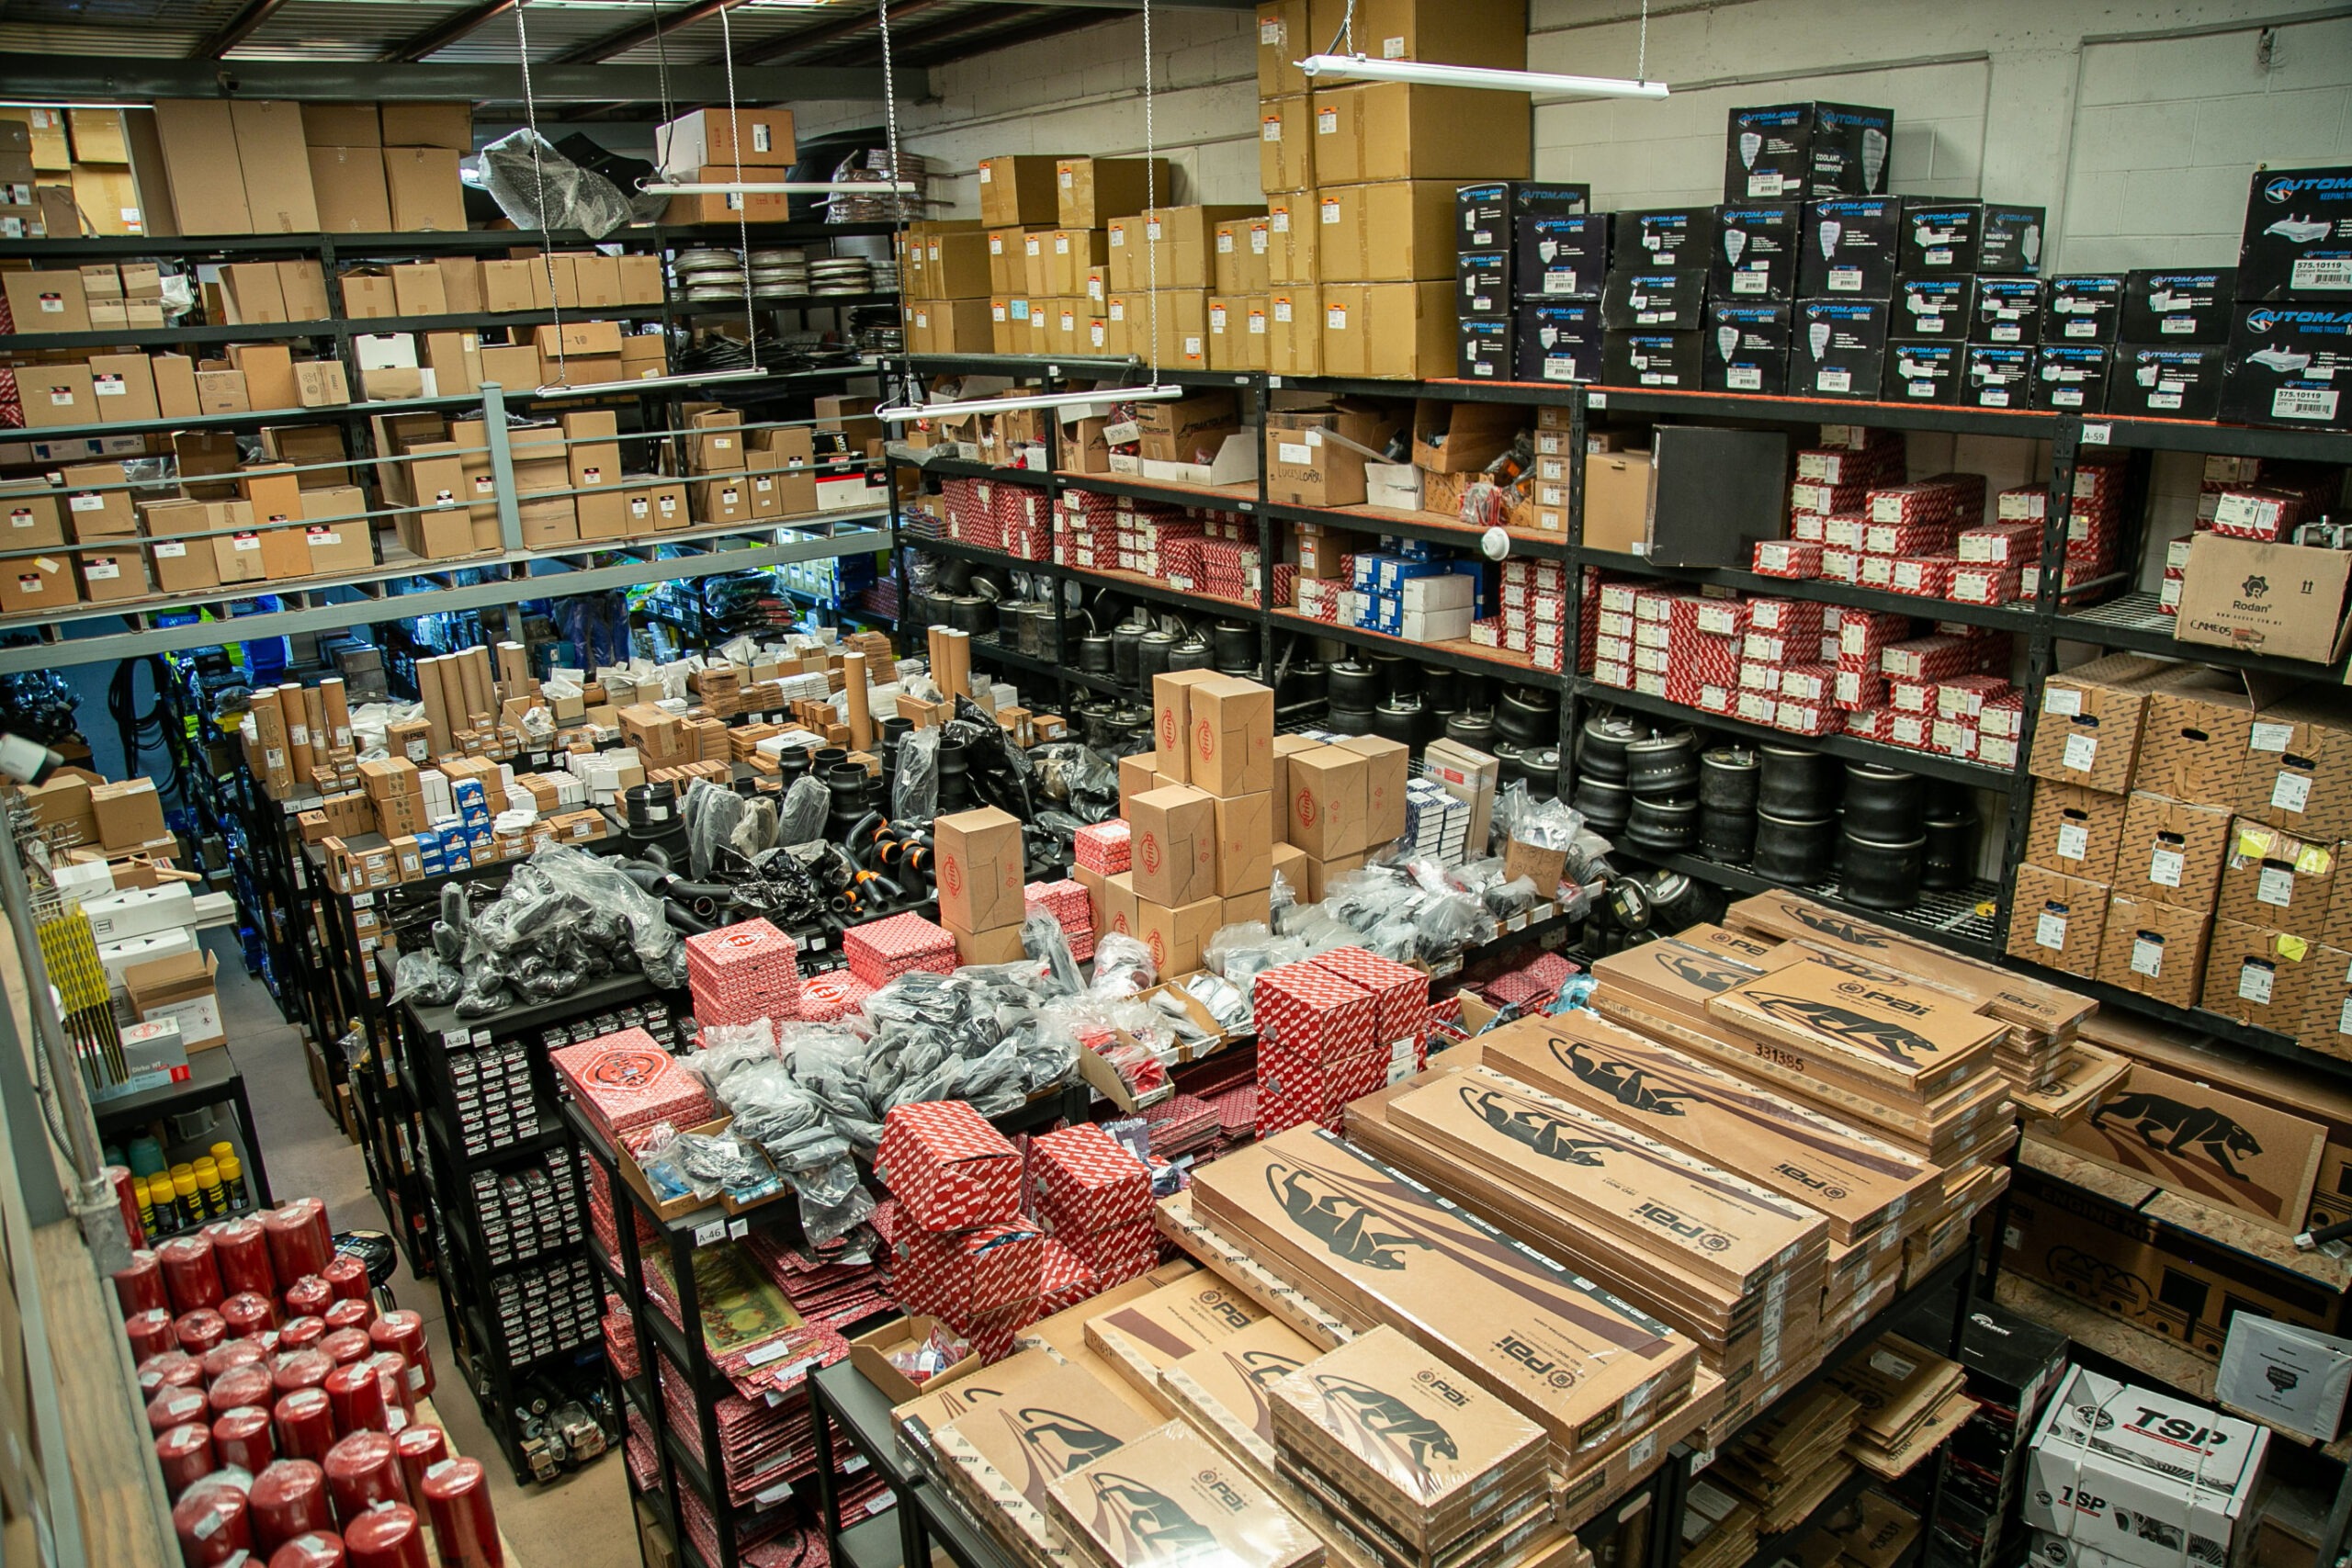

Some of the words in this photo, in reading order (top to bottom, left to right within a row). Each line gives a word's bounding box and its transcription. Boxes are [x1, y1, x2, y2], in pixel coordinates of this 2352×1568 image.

[1739, 111, 1800, 120] AUTOMANN
[1822, 112, 1886, 127] AUTOMANN
[1815, 153, 1839, 163] COOLANT
[1519, 190, 1579, 199] AUTOMANN
[2320, 192, 2345, 200] KEEPING
[1817, 202, 1883, 210] AUTOMANN
[1724, 210, 1784, 219] AUTOMANN
[1914, 213, 1969, 221] AUTOMANN
[1536, 220, 1584, 228] AUTOMANN
[2055, 278, 2117, 287] AUTOMANN
[2151, 276, 2216, 284] AUTOMANN
[1905, 282, 1962, 290] AUTOMANN
[1983, 284, 2037, 292] AUTOMANN
[1807, 305, 1872, 314] AUTOMANN
[2043, 347, 2104, 356] AUTOMANN
[2137, 350, 2202, 358] AUTOMANN
[2278, 390, 2322, 399] 575.10119
[2084, 429, 2105, 441] A-59
[2233, 600, 2268, 614] Rodan
[447, 1035, 466, 1044] A-40
[1756, 1043, 1804, 1072] 331385
[699, 1228, 721, 1243] A-46
[1605, 1295, 1631, 1312] 9001
[1630, 1309, 1648, 1321] ISO
[2135, 1406, 2228, 1447] TSP
[2062, 1484, 2106, 1511] TSP
